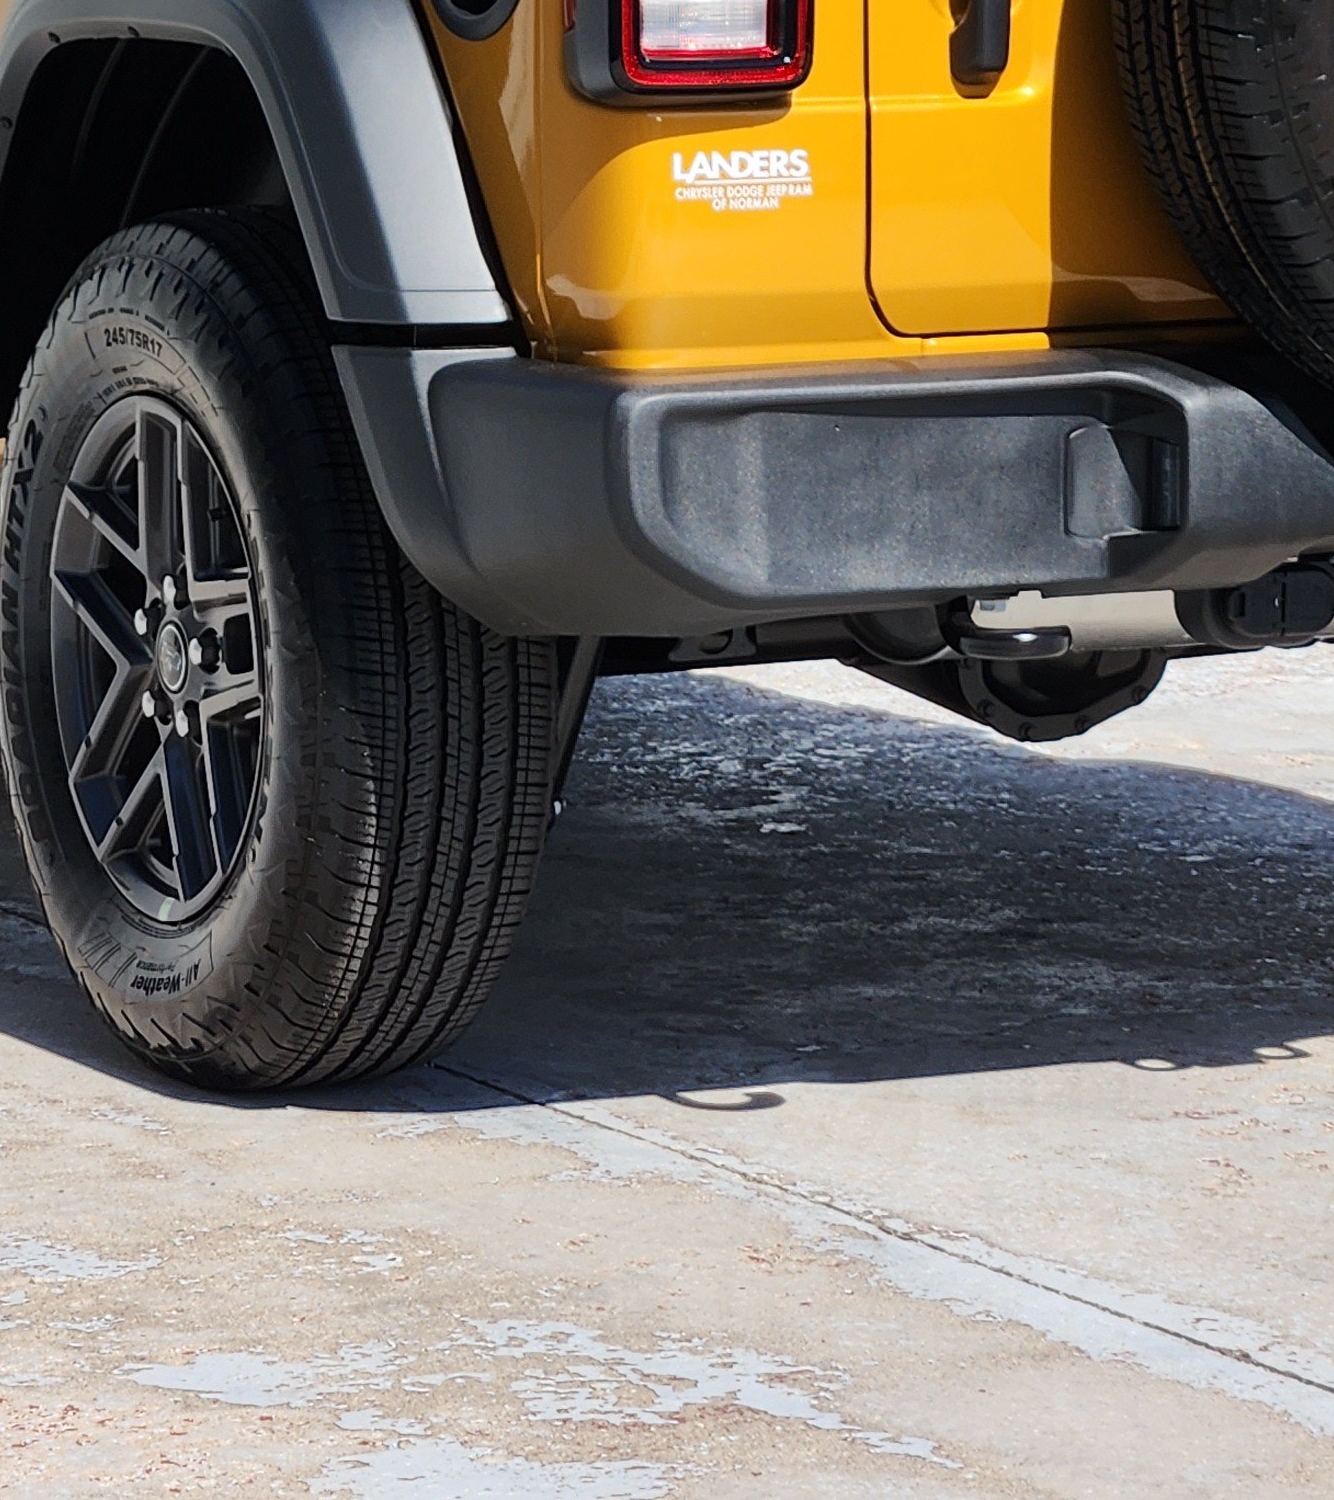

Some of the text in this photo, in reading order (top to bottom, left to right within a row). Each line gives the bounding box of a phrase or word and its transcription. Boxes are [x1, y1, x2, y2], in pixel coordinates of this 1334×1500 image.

[673, 149, 809, 182] LANDERS
[676, 184, 812, 199] CHRYSLER DODGE JEEP RAM
[712, 197, 779, 211] OF NORMAN
[103, 327, 163, 358] 245/75R17
[130, 958, 201, 997] All-Weather
